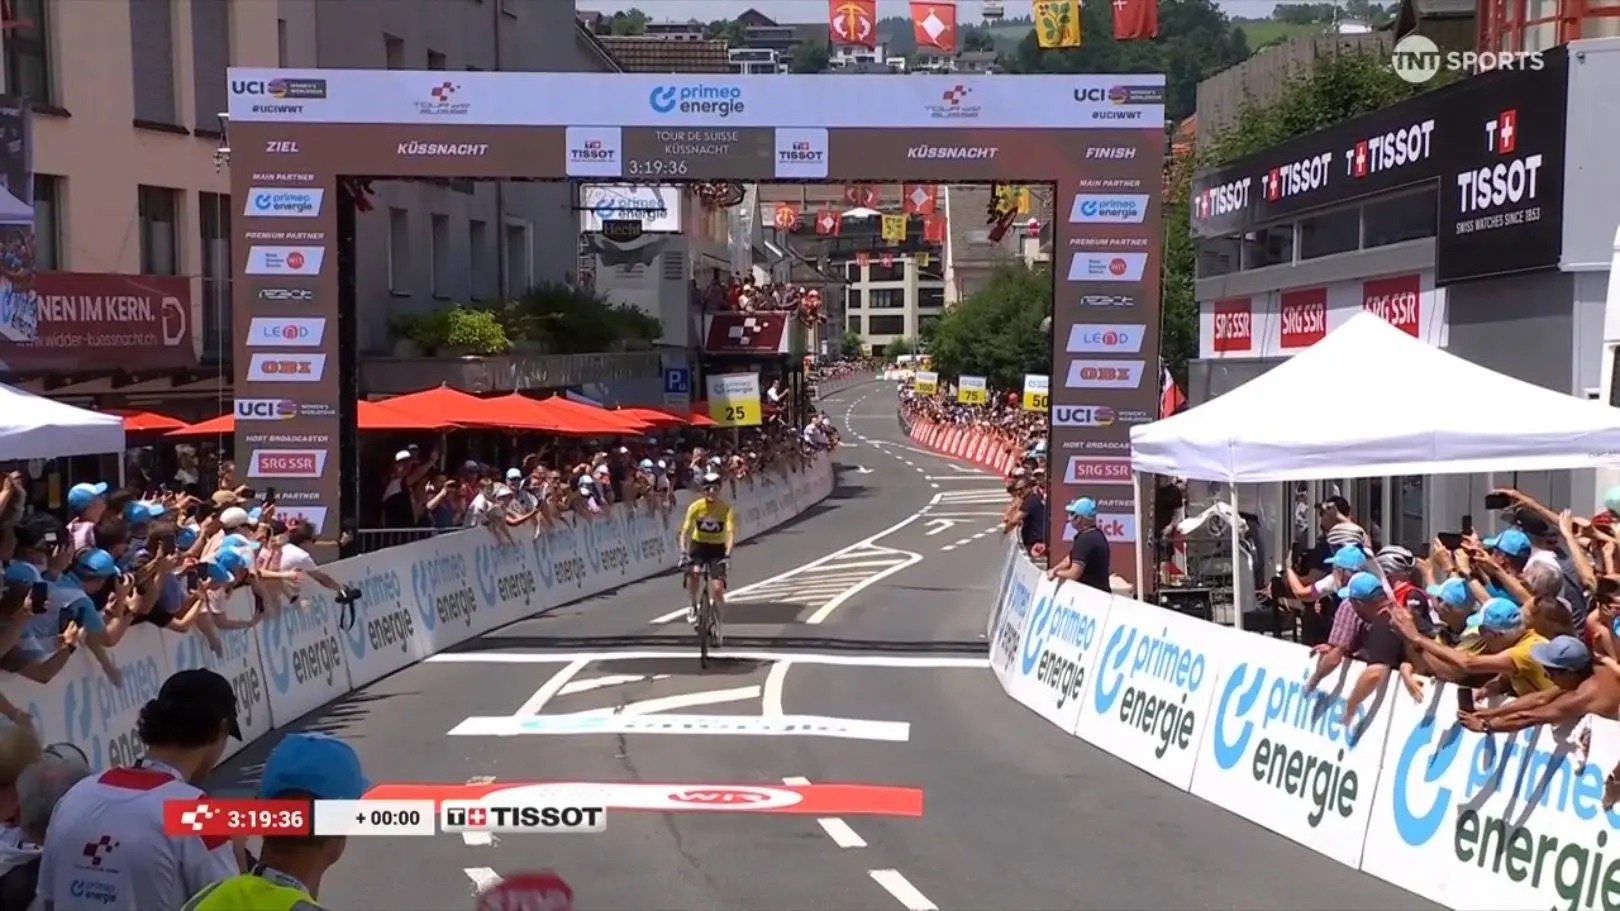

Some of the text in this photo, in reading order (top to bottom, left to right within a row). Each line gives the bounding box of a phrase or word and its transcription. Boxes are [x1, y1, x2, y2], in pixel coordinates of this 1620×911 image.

[231, 81, 265, 95] UCI
[680, 84, 741, 101] primeo
[1073, 88, 1106, 102] UCI
[680, 100, 745, 117] energie
[656, 131, 738, 141] TOUR DE SUISSE
[265, 141, 300, 153] ZIEL
[396, 141, 489, 156] KÜSSNACHT
[570, 150, 615, 159] TISSOT
[906, 145, 999, 159] KÜSSNACHT
[1085, 147, 1137, 159] FINISH
[1368, 119, 1435, 173] TISSOT
[779, 151, 823, 161] TISSOT
[628, 160, 688, 175] 3:19:36
[1280, 151, 1332, 197] TISSOT
[276, 173, 315, 181] PARTNER
[1457, 153, 1543, 213] TISSOT
[1209, 176, 1251, 217] TISSOT
[273, 202, 313, 213] energie
[1098, 209, 1137, 220] energie
[1456, 219, 1474, 235] SWISS
[1475, 214, 1503, 231] WATCHES
[1504, 209, 1525, 226] SINCE
[80, 295, 103, 322] IM
[106, 296, 155, 322] KERN.
[1391, 291, 1416, 325] SSR
[1215, 311, 1249, 339] SRG SSR
[1282, 303, 1325, 336] SRG SSR
[669, 371, 680, 389] P
[918, 383, 934, 391] 100
[965, 391, 978, 400] 75
[1032, 395, 1048, 407] 50
[238, 402, 273, 417] UCI
[725, 406, 745, 421] 25
[1056, 409, 1091, 422] UCI
[261, 458, 314, 469] SRG SSR
[1077, 464, 1129, 476] SRG SSR
[497, 562, 536, 606] energie
[436, 580, 477, 627] energie
[367, 601, 414, 653] energie
[1050, 597, 1096, 652] primeo
[292, 628, 341, 686] energie
[1129, 626, 1205, 693] primeo
[1037, 649, 1086, 710] energie
[1262, 668, 1366, 751] primeo
[1119, 686, 1195, 760] energie
[1252, 737, 1359, 828] energie
[1454, 809, 1620, 911] energie
